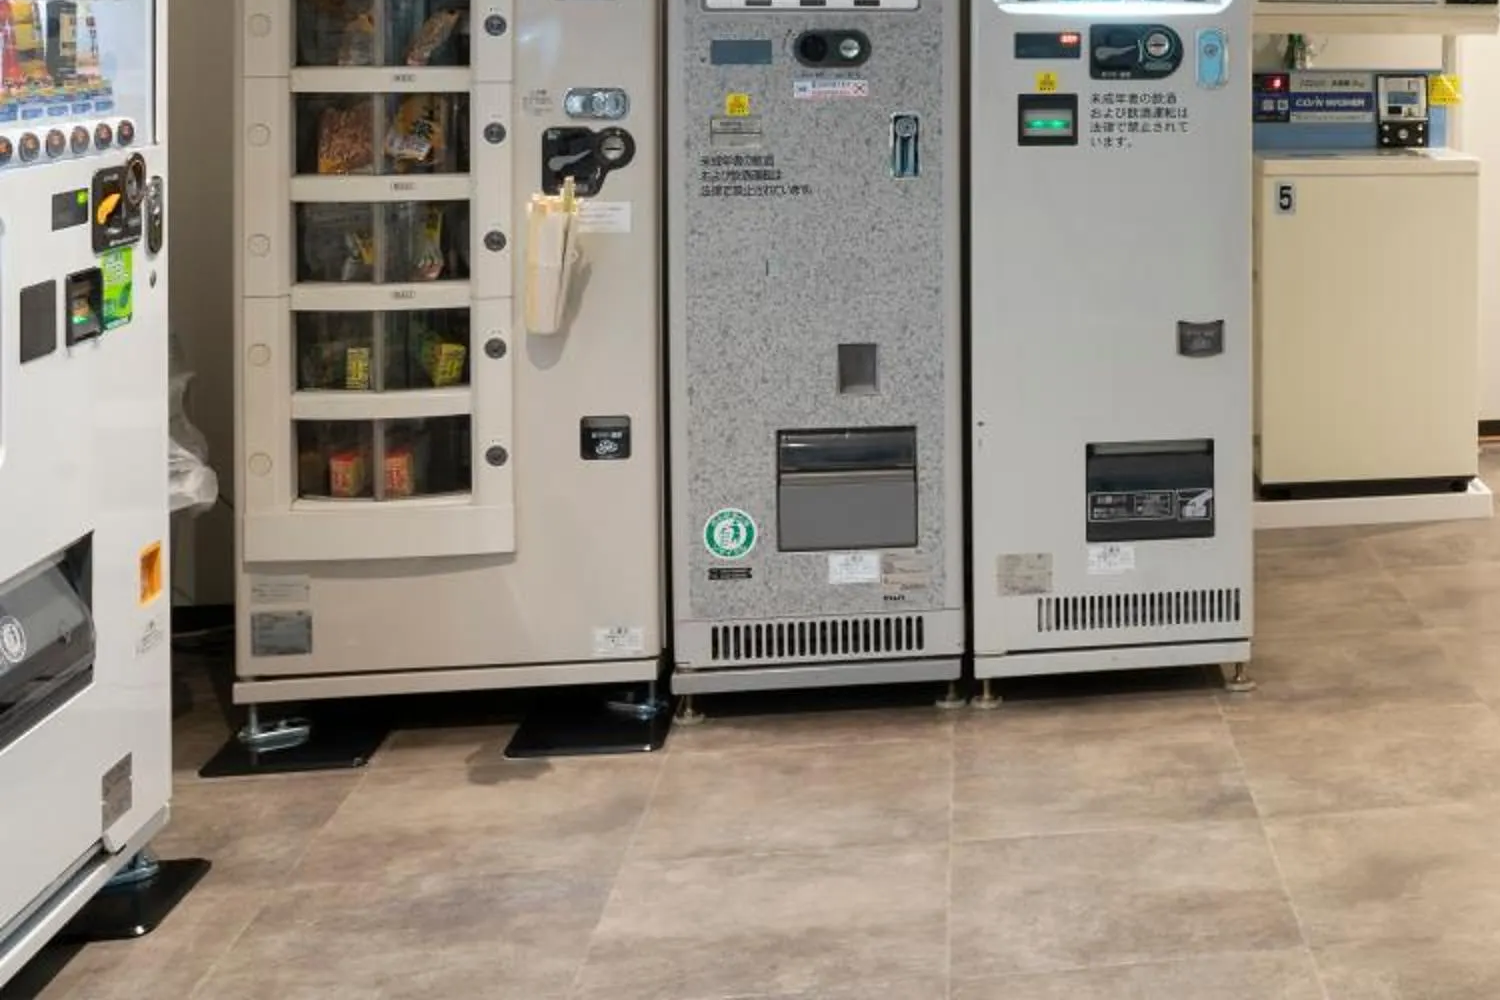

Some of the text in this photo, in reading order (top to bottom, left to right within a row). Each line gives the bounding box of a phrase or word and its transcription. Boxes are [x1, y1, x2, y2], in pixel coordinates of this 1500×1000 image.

[1090, 121, 1189, 133] 法律で禁止されて
[1279, 186, 1292, 210] 5
